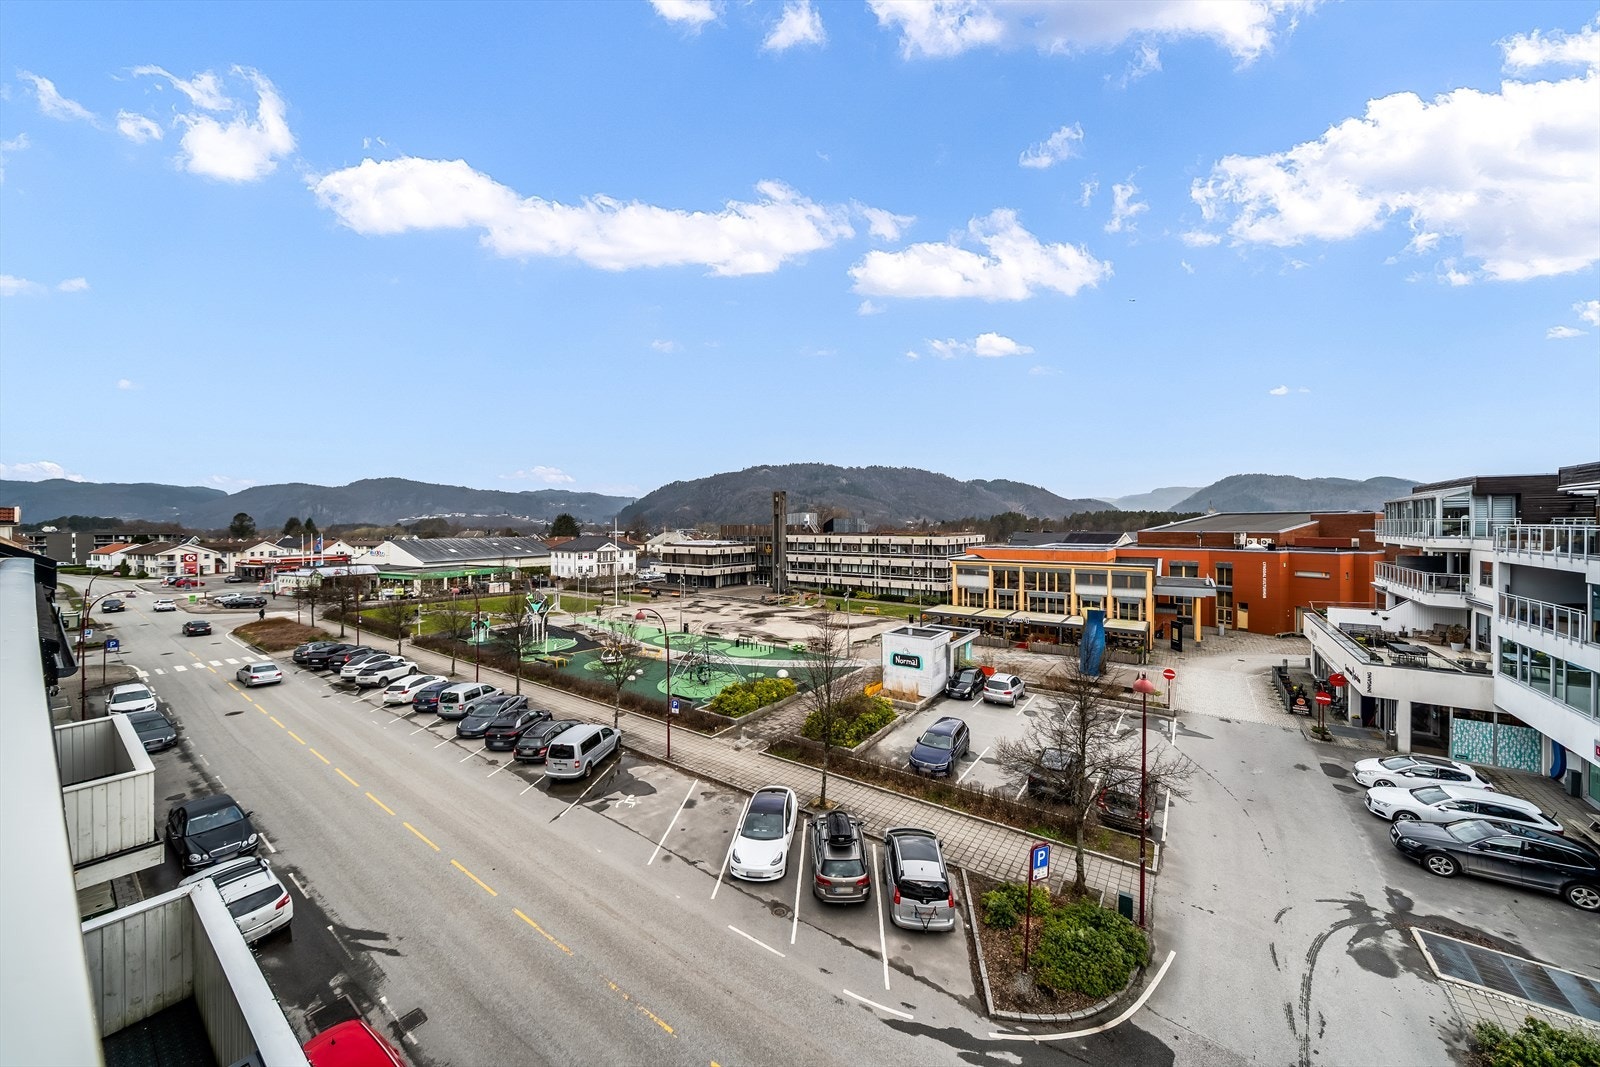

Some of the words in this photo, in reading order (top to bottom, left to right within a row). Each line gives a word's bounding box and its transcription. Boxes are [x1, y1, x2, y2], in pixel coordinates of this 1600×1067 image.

[895, 655, 918, 666] Normal
[673, 700, 678, 708] P
[1037, 850, 1046, 867] P
